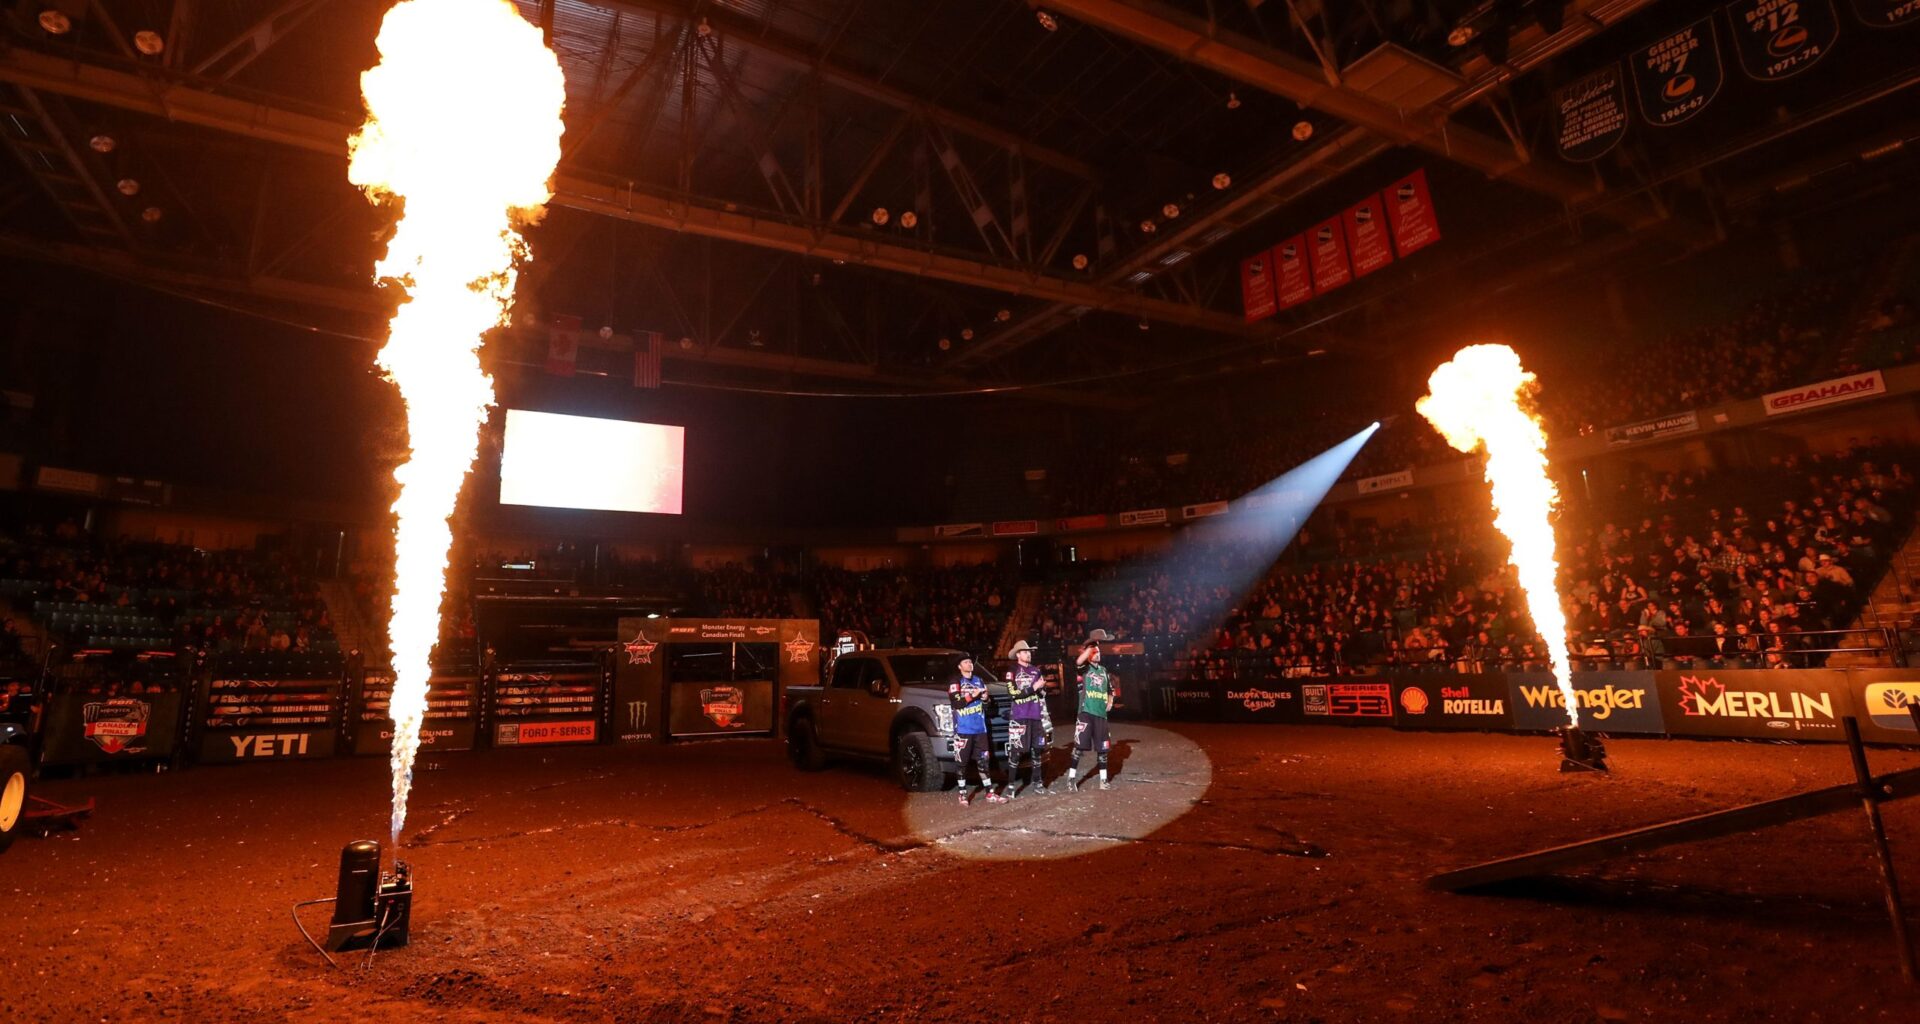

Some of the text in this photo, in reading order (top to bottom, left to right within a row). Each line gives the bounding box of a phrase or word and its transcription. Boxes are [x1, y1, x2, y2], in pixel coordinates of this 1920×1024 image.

[1752, 2, 1799, 32] #12
[1647, 38, 1699, 69] PINDER
[1648, 28, 1693, 57] GERRY
[1658, 52, 1689, 74] #7
[1767, 45, 1820, 76] 1971-74
[1660, 95, 1704, 122] 1965-67
[1773, 376, 1874, 407] GRAHAM
[1626, 424, 1655, 436] KEVIN
[1657, 416, 1695, 428] WAUGH
[1227, 691, 1292, 699] DAKOTA DUNES
[1244, 699, 1276, 708] CASINO
[1305, 688, 1324, 696] BUILT
[1442, 687, 1469, 698] Shell
[1444, 700, 1504, 714] ROTELLA
[1695, 691, 1834, 719] MERLIN
[522, 726, 592, 738] FORD F-SERIES
[230, 733, 309, 757] YETI
